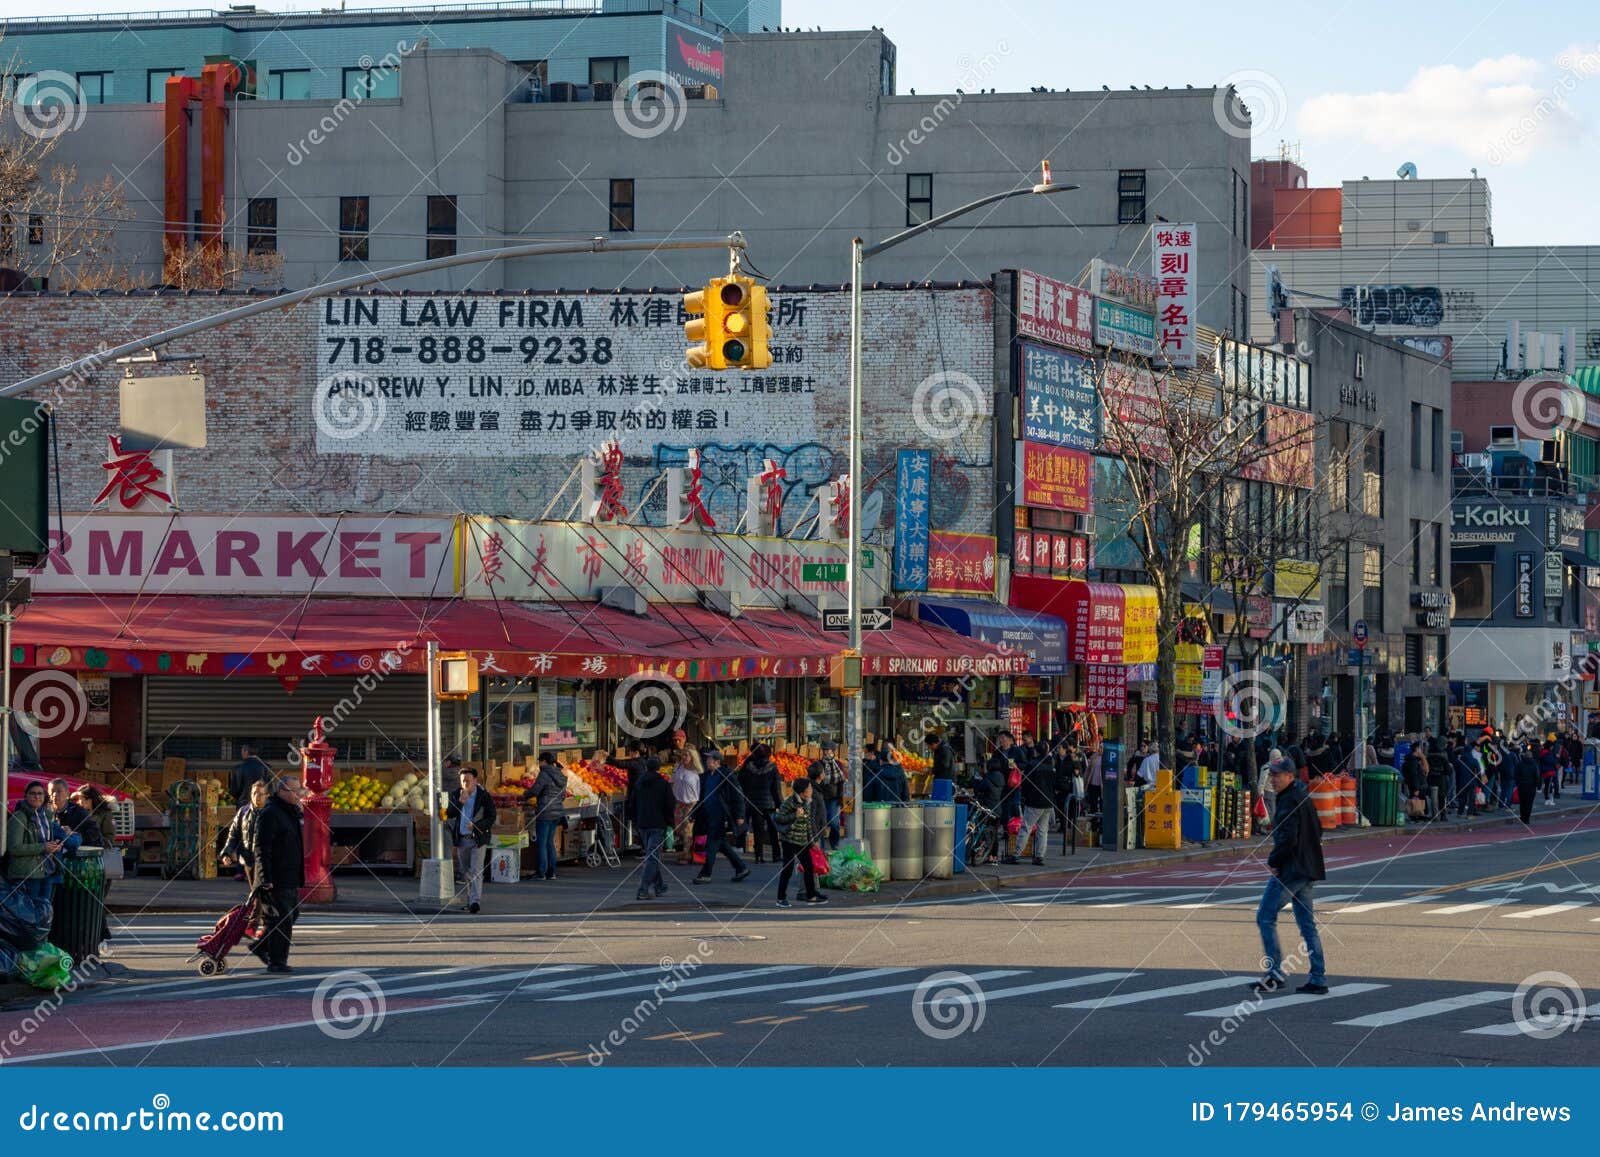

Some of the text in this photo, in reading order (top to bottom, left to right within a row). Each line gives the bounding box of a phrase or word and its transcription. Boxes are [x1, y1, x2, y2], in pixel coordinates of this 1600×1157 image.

[1157, 231, 1192, 248] 快速
[1160, 252, 1189, 350] 刻章名片
[326, 298, 583, 328] LIN LAW FIRM
[326, 336, 613, 365] 718-888-9238
[327, 376, 424, 399] ANDREW
[436, 377, 455, 397] Y.
[544, 378, 584, 397] MBA
[405, 410, 500, 431] 經驗豐富
[662, 546, 725, 586] SPARKLING
[816, 567, 828, 579] 41
[828, 614, 883, 626] ONE WAY
[889, 658, 938, 673] SPARKLING
[946, 657, 1025, 673] SUPERMARKET
[1109, 752, 1117, 762] P
